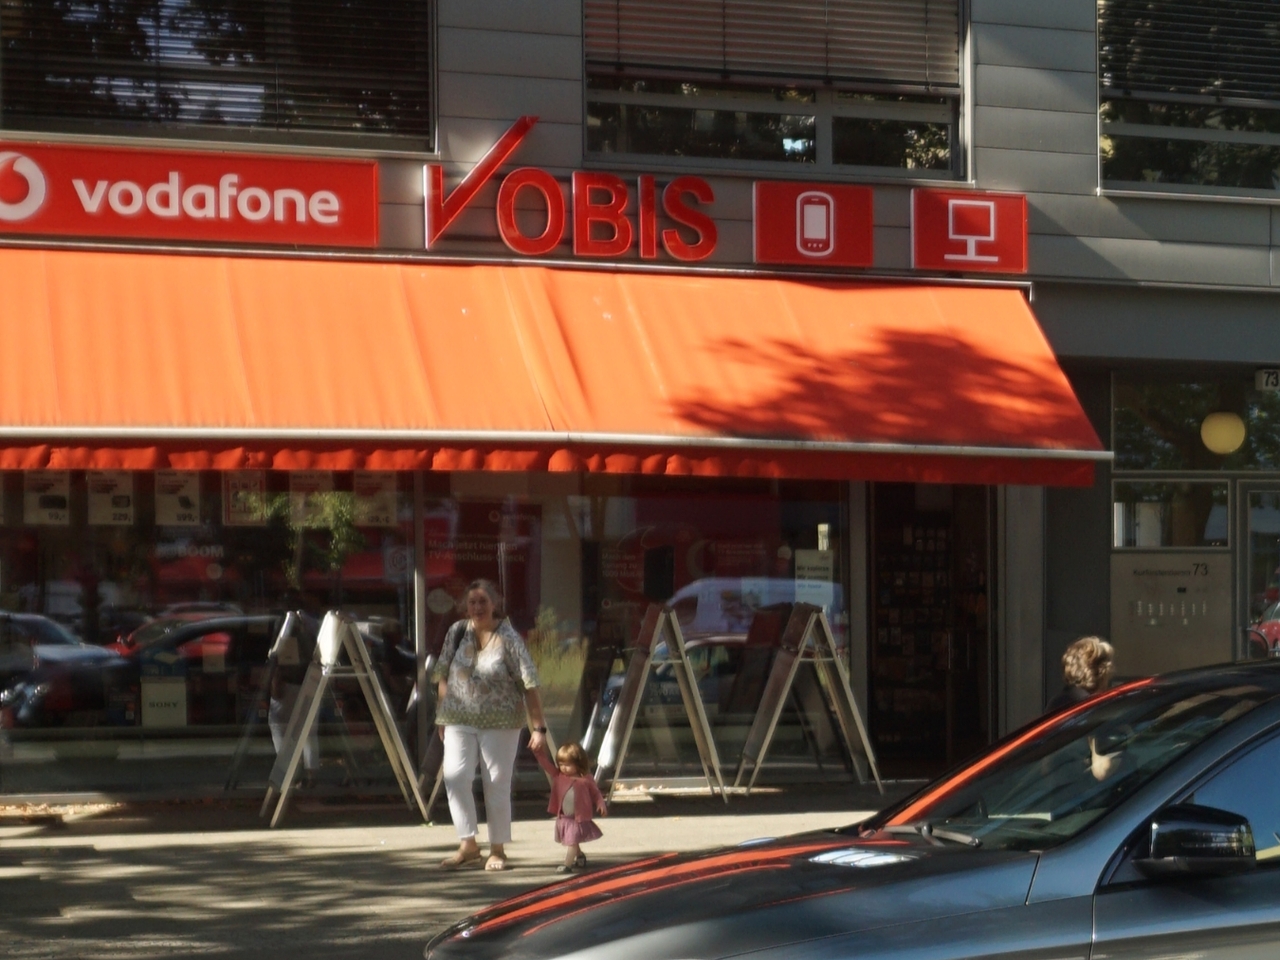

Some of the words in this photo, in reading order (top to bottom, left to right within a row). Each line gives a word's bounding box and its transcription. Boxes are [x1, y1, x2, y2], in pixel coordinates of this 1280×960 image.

[72, 170, 342, 226] vodafone
[423, 115, 718, 263] VOBIS
[1264, 371, 1279, 387] 73
[1192, 563, 1209, 576] 73
